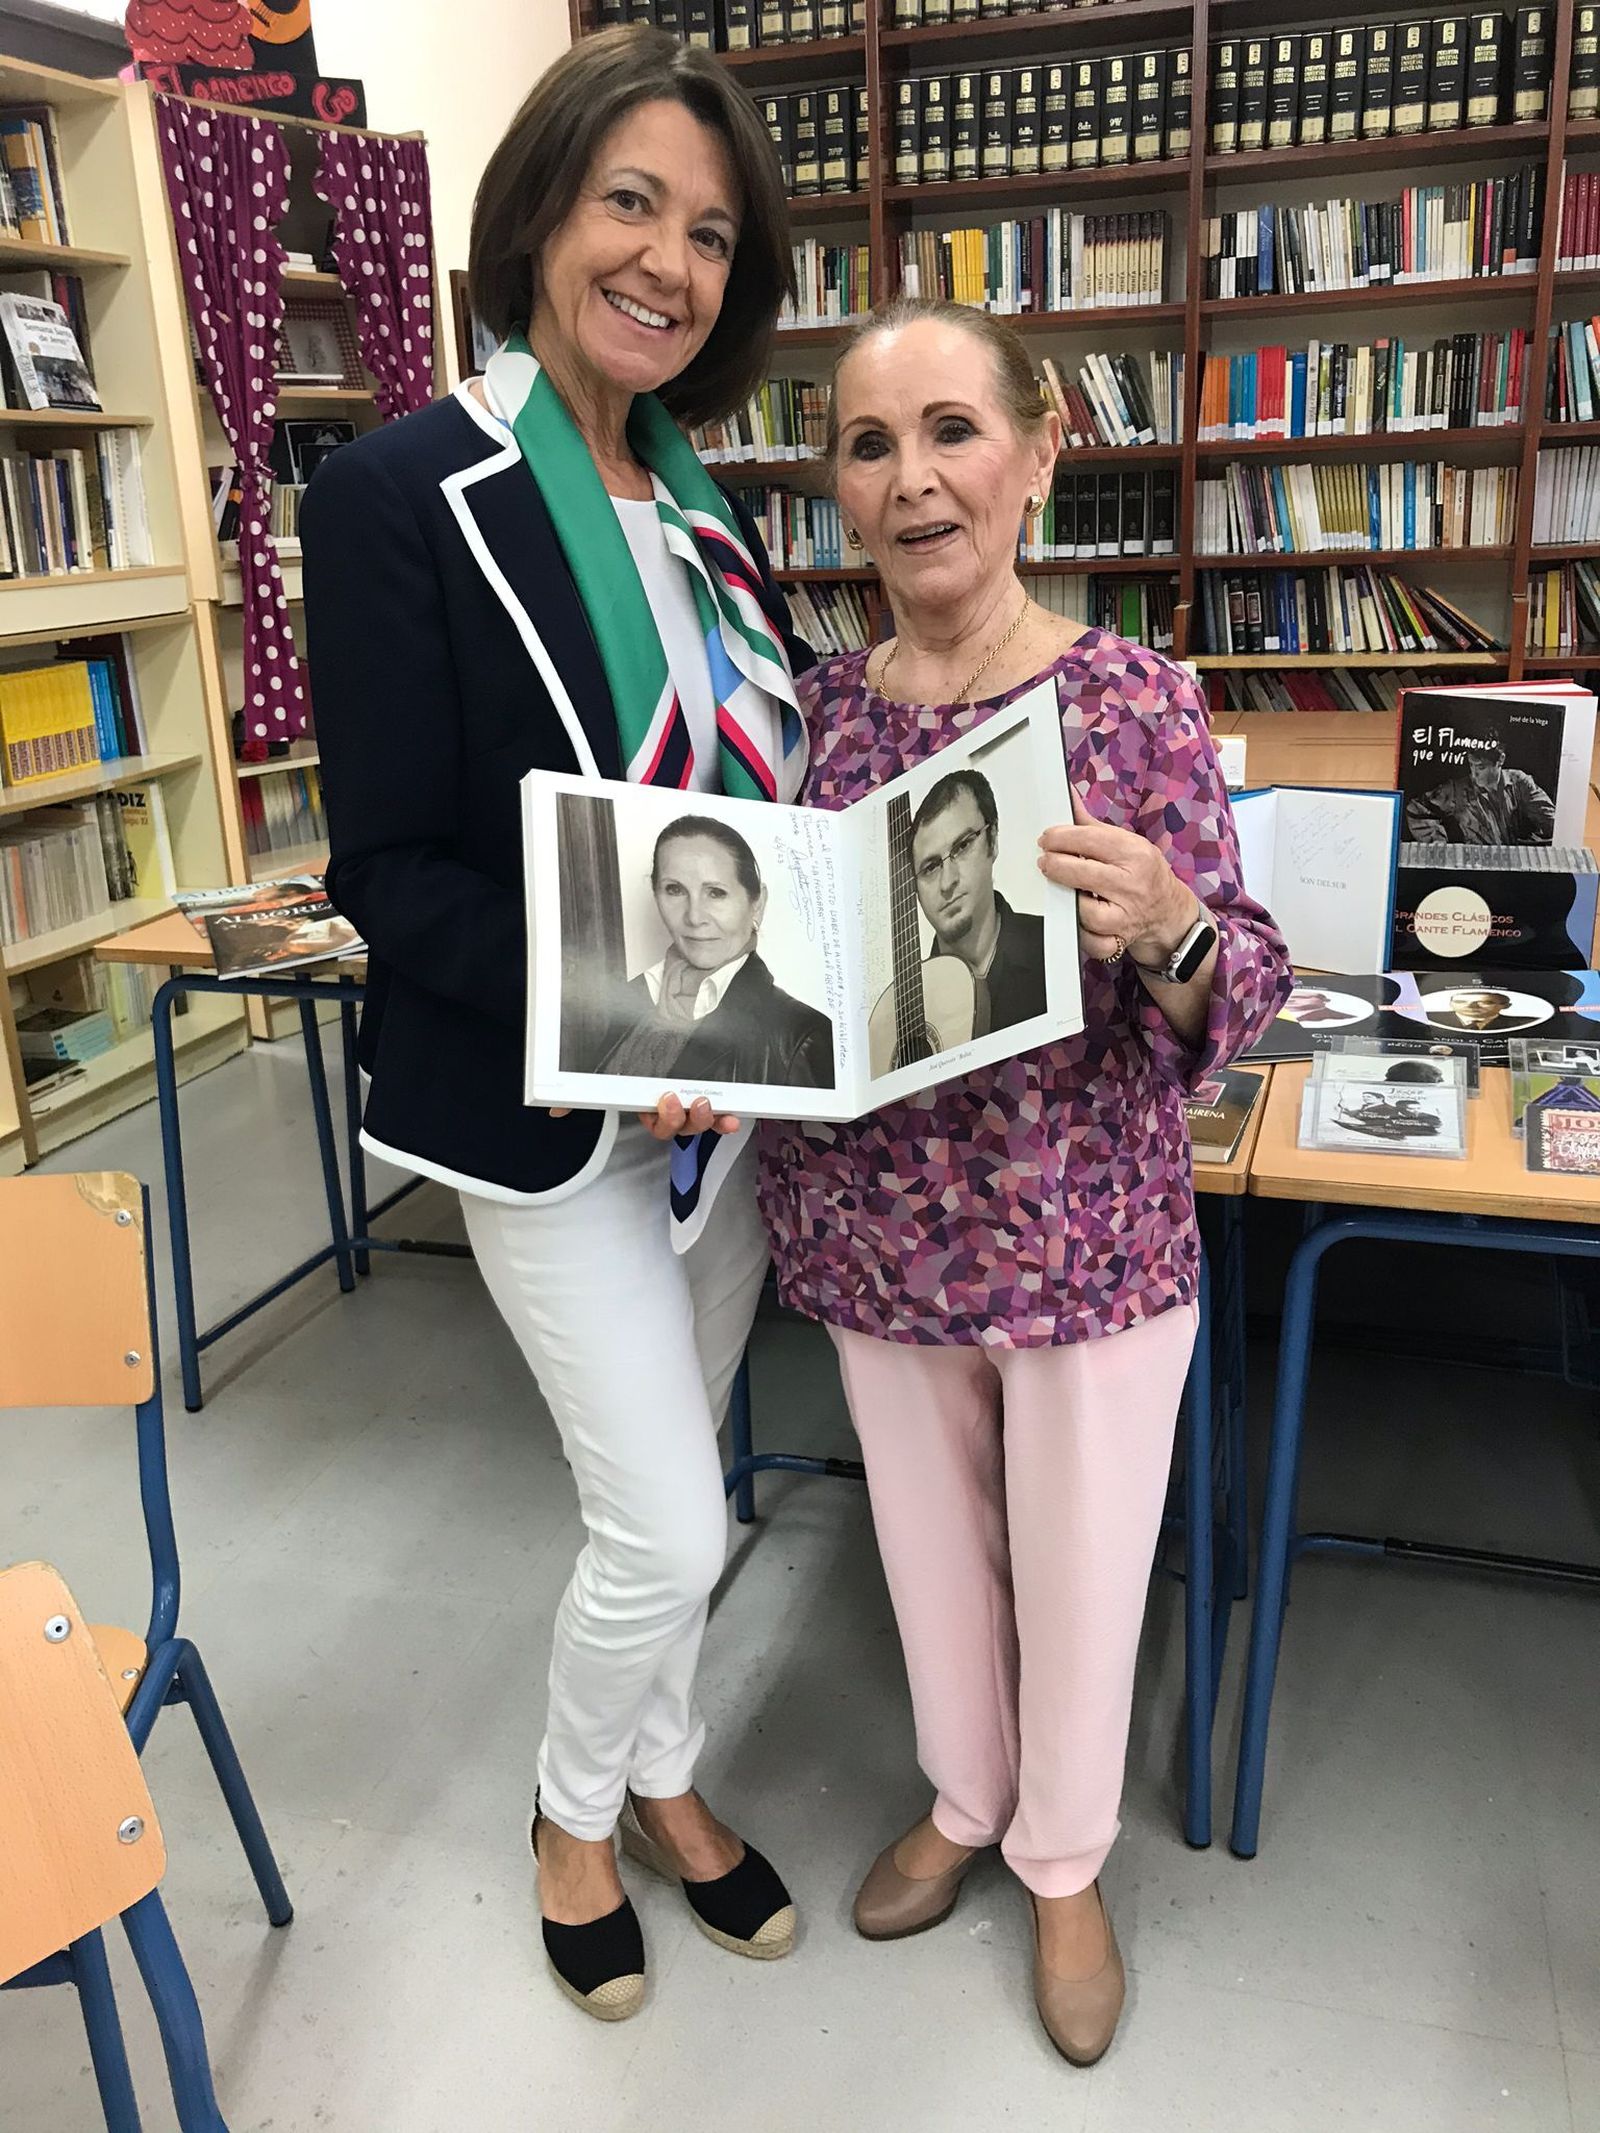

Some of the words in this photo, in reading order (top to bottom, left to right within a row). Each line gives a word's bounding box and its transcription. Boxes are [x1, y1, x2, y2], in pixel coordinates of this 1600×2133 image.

[1509, 715, 1522, 723] José
[1535, 718, 1549, 727] Vega
[1412, 725, 1432, 745] El
[1438, 727, 1498, 750] Flamenco
[1412, 750, 1434, 766] que
[1440, 751, 1467, 765] viví
[1451, 911, 1514, 924] CLÁSICOS
[1406, 924, 1449, 935] CANTE
[1452, 925, 1522, 938] FLAMENCO
[1183, 1106, 1226, 1120] AIRENA
